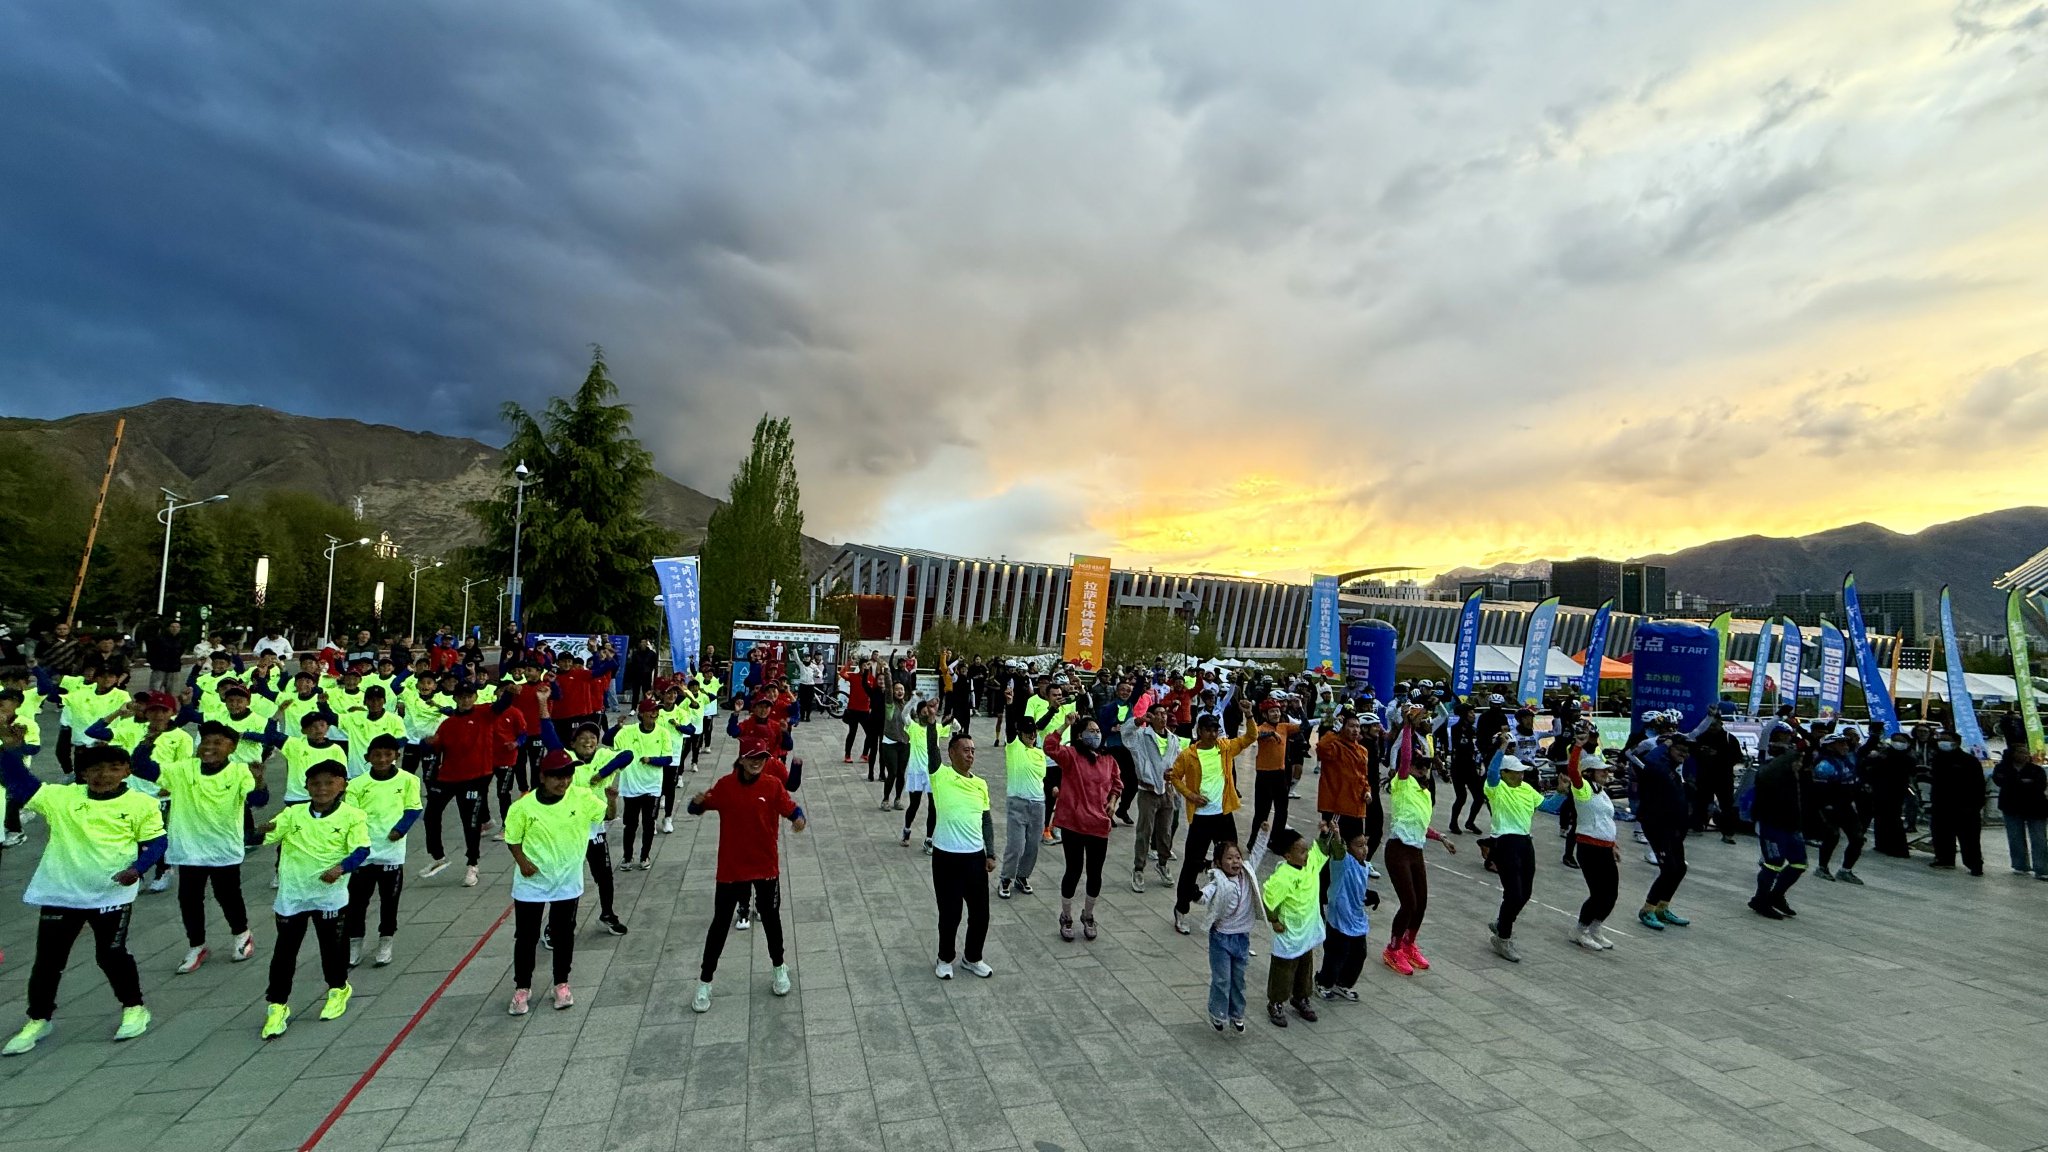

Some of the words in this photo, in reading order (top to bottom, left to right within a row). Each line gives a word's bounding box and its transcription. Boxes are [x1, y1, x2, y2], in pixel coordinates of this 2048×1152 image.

[1078, 580, 1098, 647] 拉萨市体育总会
[1525, 618, 1550, 693] 拉萨市体育局
[1671, 645, 1709, 656] START
[1644, 673, 1681, 683] 主办单位
